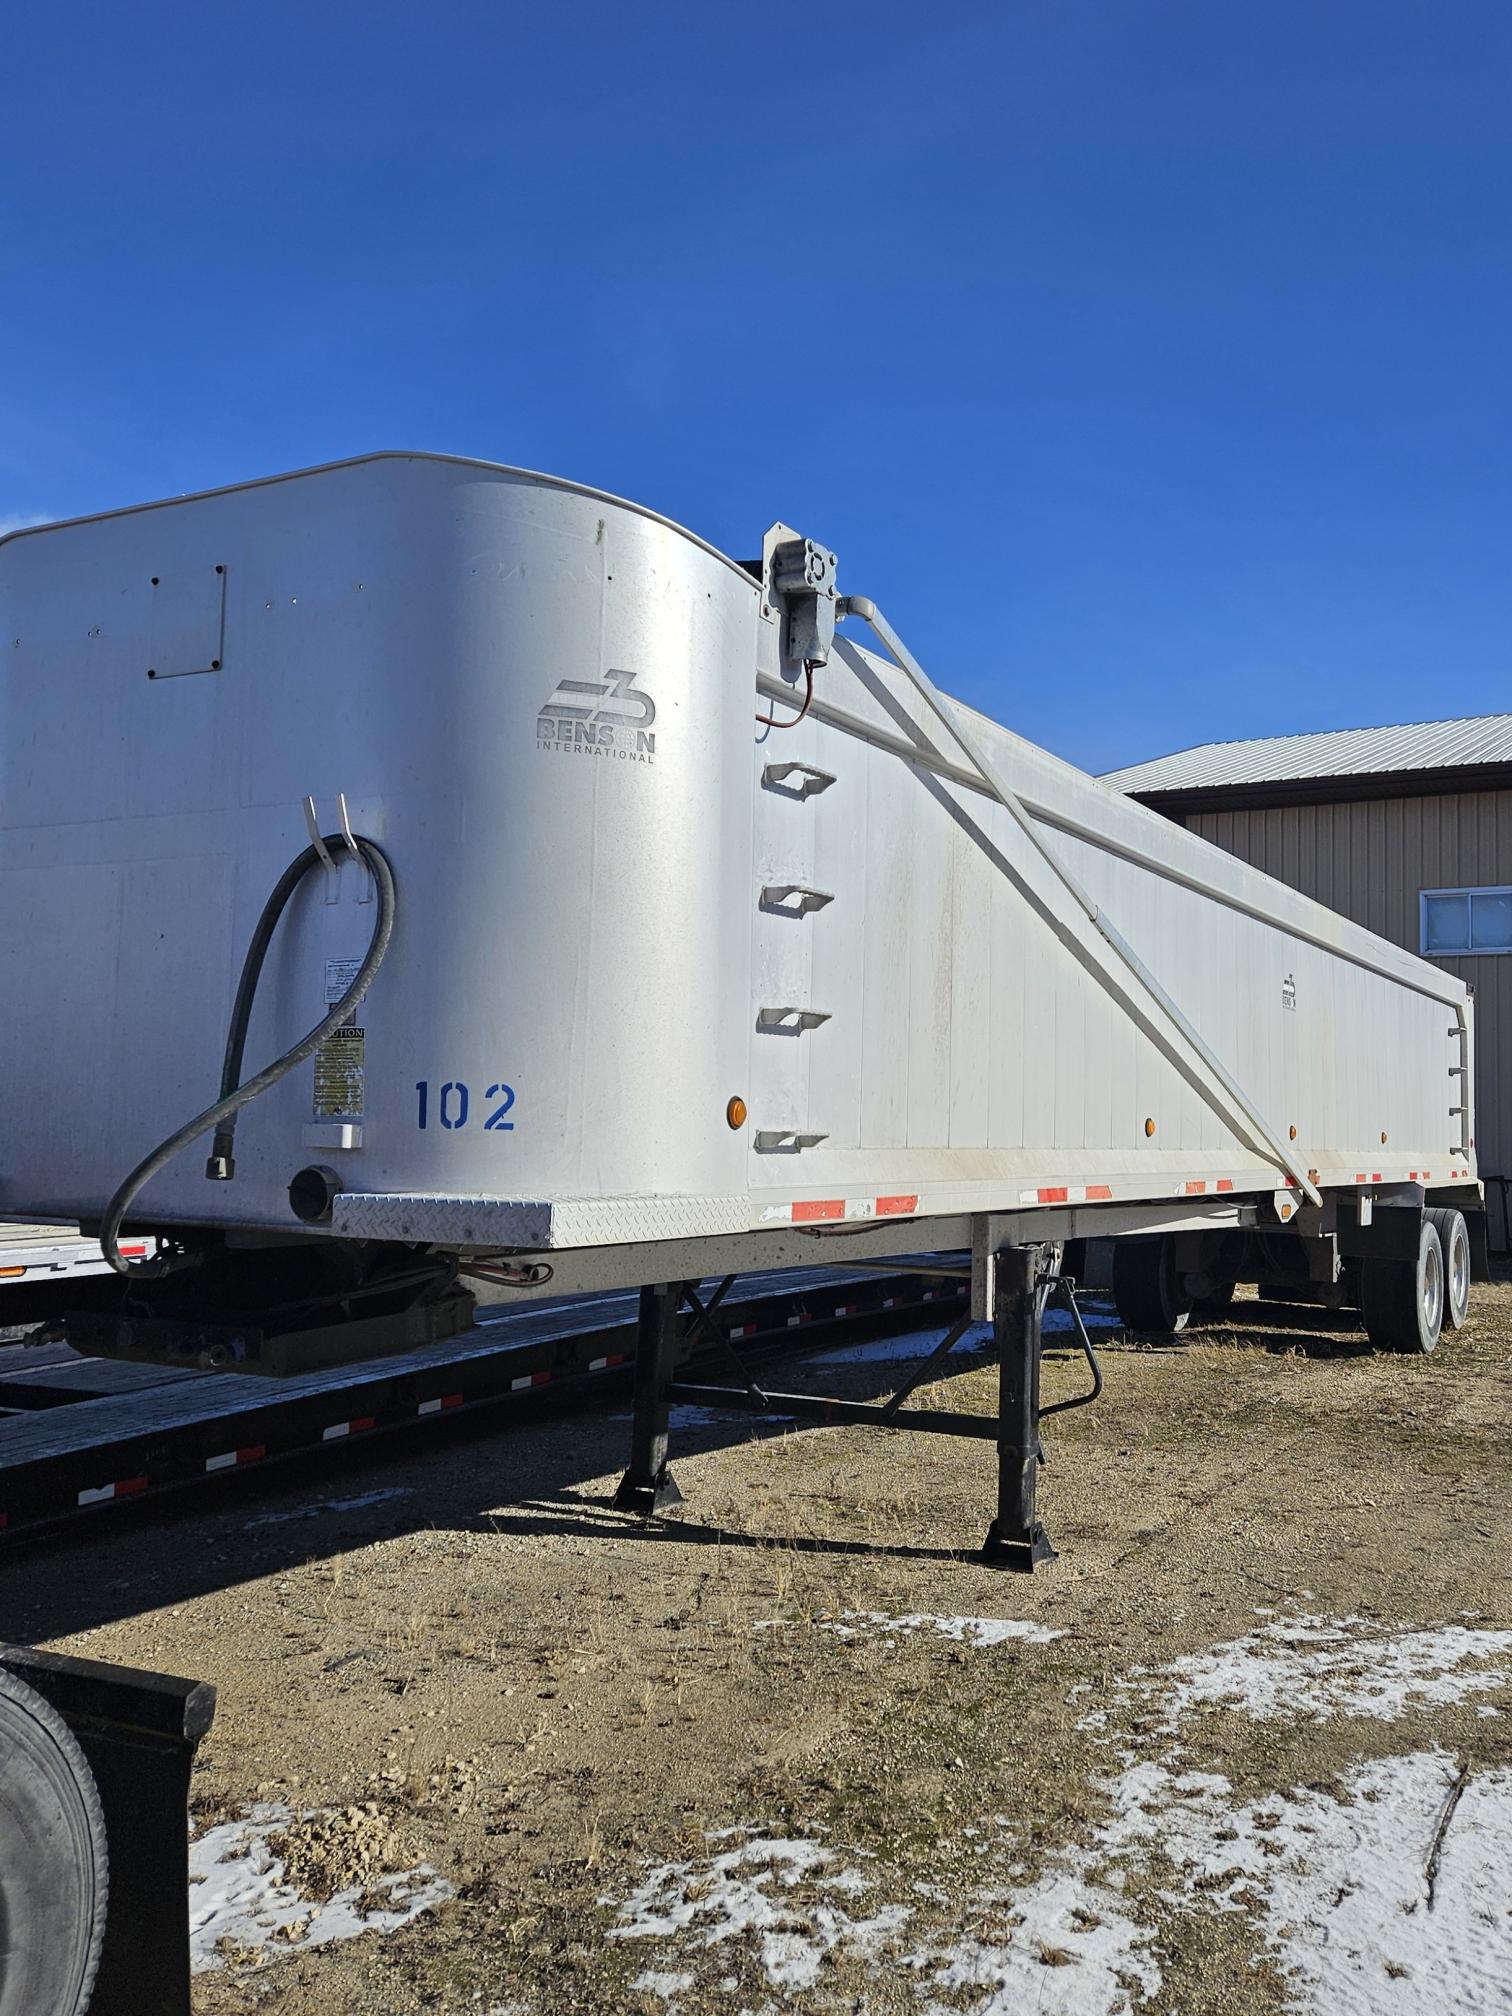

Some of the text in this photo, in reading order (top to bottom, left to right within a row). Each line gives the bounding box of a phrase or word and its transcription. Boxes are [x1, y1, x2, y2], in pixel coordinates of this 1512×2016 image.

[536, 718, 655, 753] BENSON
[536, 741, 655, 764] INTERNATIONAL
[332, 1029, 363, 1038] UTION
[416, 1081, 515, 1130] 102
